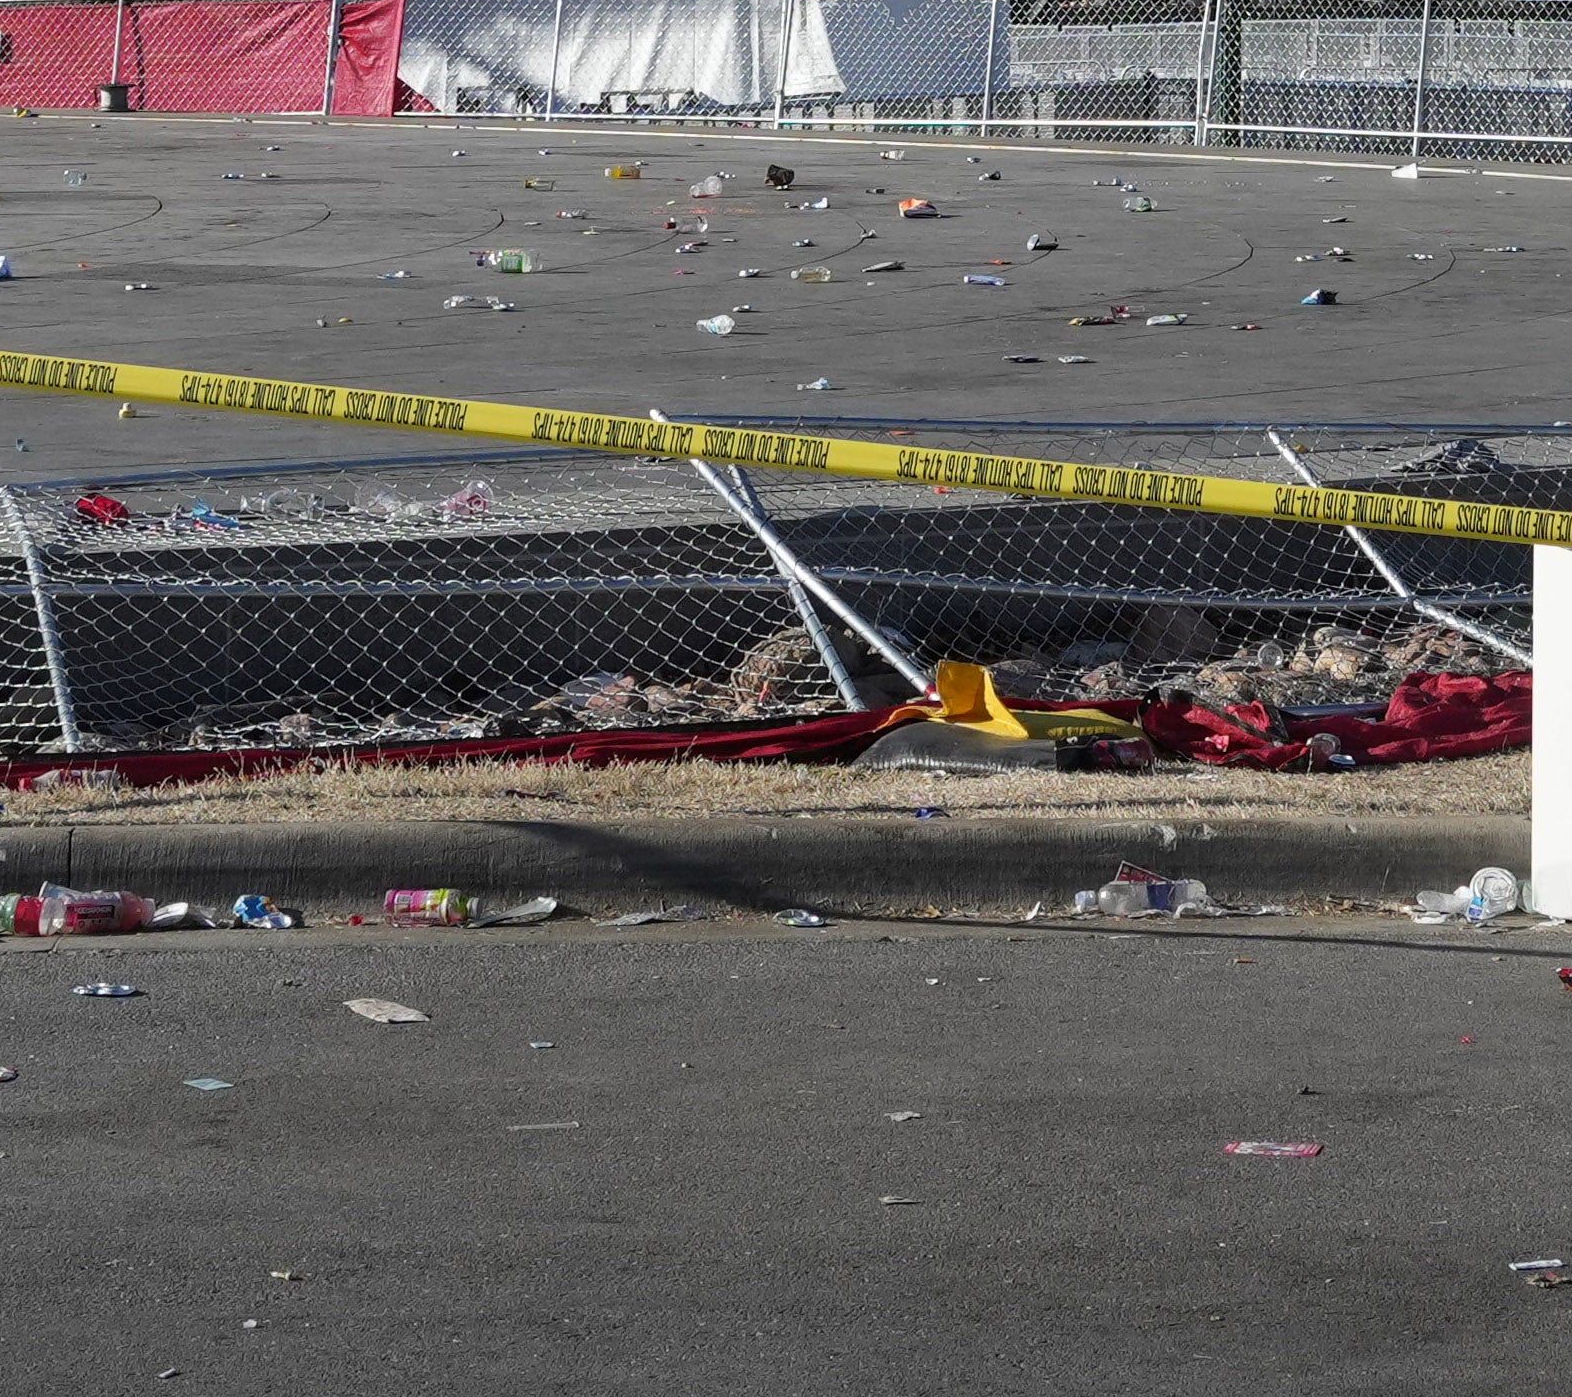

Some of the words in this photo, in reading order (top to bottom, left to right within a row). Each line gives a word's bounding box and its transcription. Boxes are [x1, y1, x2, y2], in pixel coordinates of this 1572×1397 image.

[180, 374, 222, 405] 474-TIPS
[224, 378, 250, 408] (816)
[250, 382, 289, 411] HOTLINE
[289, 385, 311, 414] TIPS
[313, 388, 336, 417] CALL
[344, 391, 376, 420] CROSS
[376, 395, 397, 423] NOT
[397, 397, 413, 425] DO
[412, 398, 434, 426] LINE
[434, 401, 468, 431] POLICE
[897, 449, 942, 480] 474-TIPS
[945, 454, 971, 483] (816)
[972, 457, 1014, 487] HOTLINE
[1014, 460, 1036, 489] TIPS
[1040, 463, 1063, 492] CALL
[1073, 466, 1106, 496] CROSS
[1109, 470, 1129, 499] NOT
[1130, 472, 1145, 500] DO
[1146, 473, 1168, 503] LINE
[1170, 476, 1204, 506] POLICE
